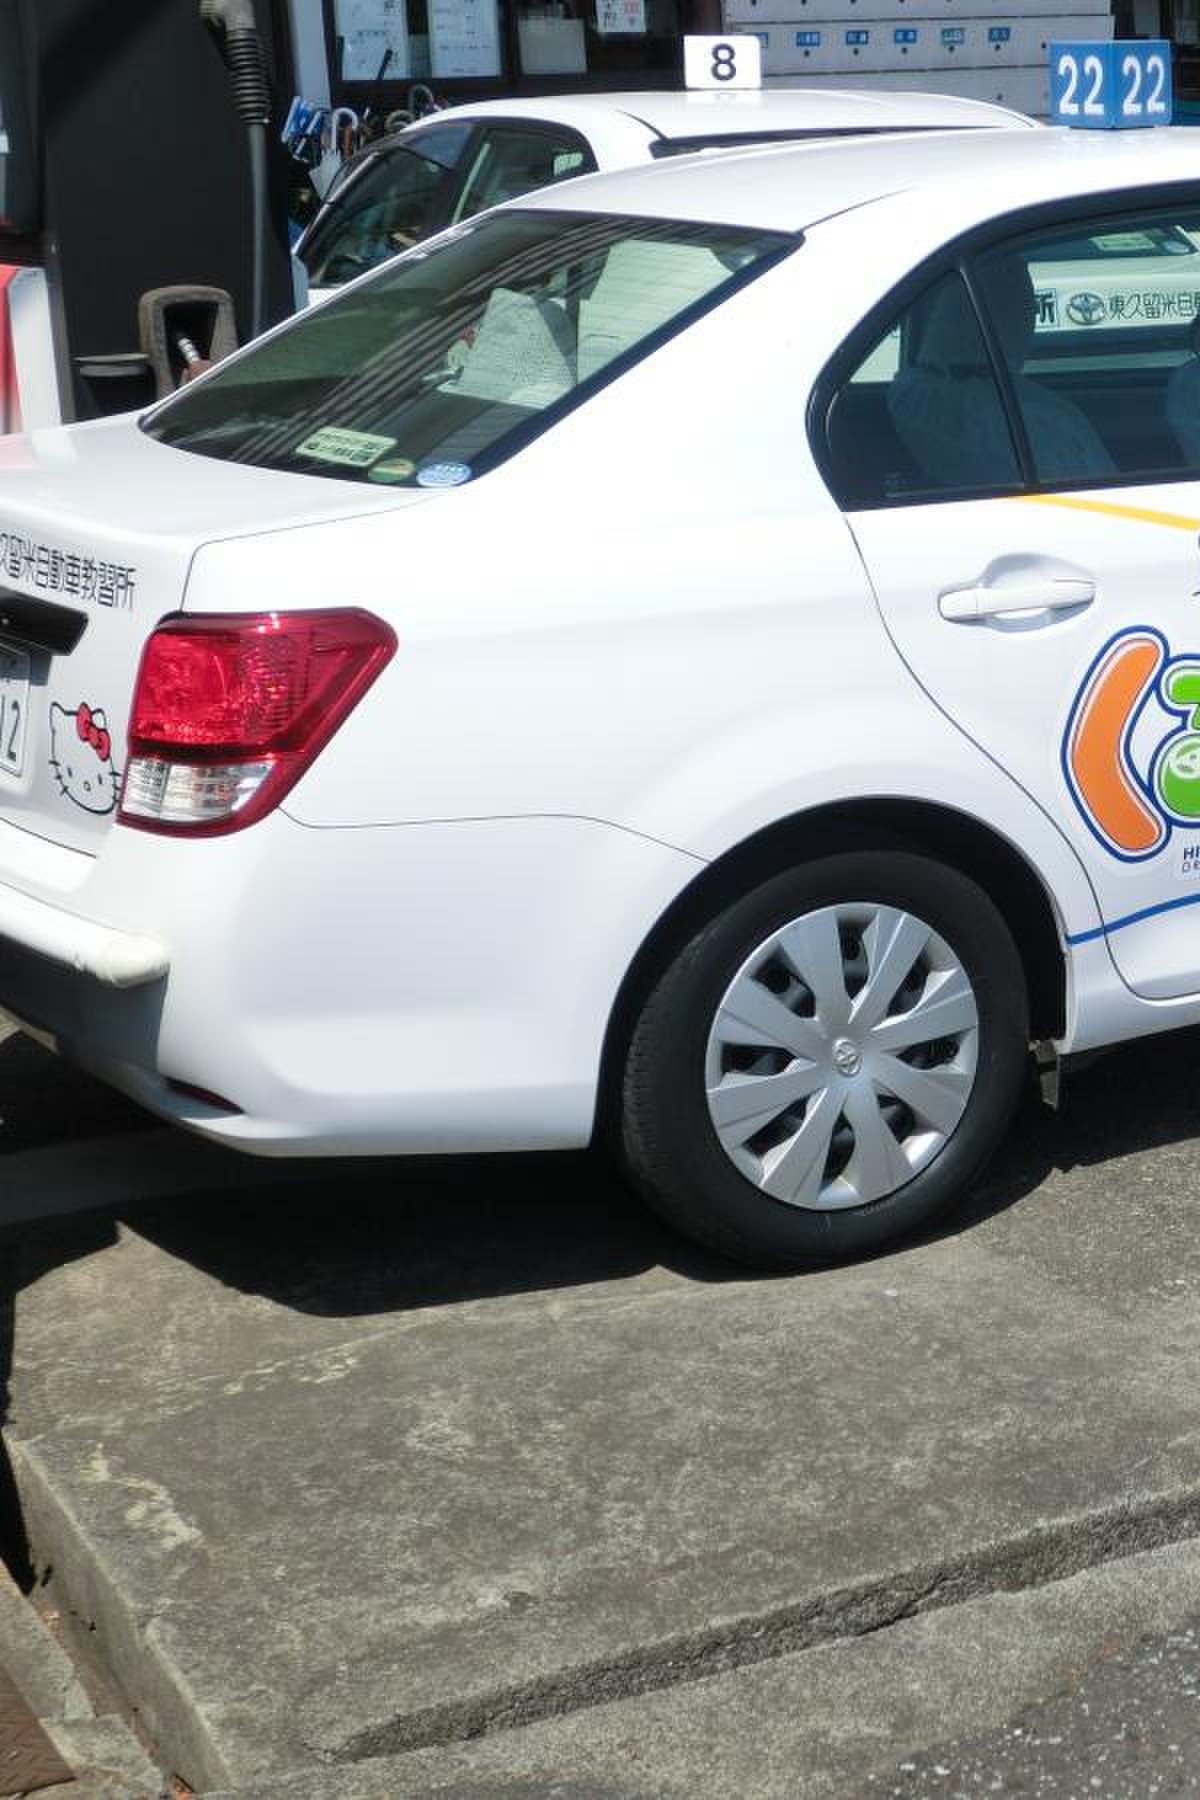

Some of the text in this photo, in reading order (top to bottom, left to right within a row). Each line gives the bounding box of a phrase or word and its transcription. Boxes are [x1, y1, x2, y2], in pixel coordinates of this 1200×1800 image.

[711, 43, 737, 81] 8
[1059, 54, 1104, 115] 22
[1123, 54, 1165, 115] 22
[0, 694, 20, 763] 2
